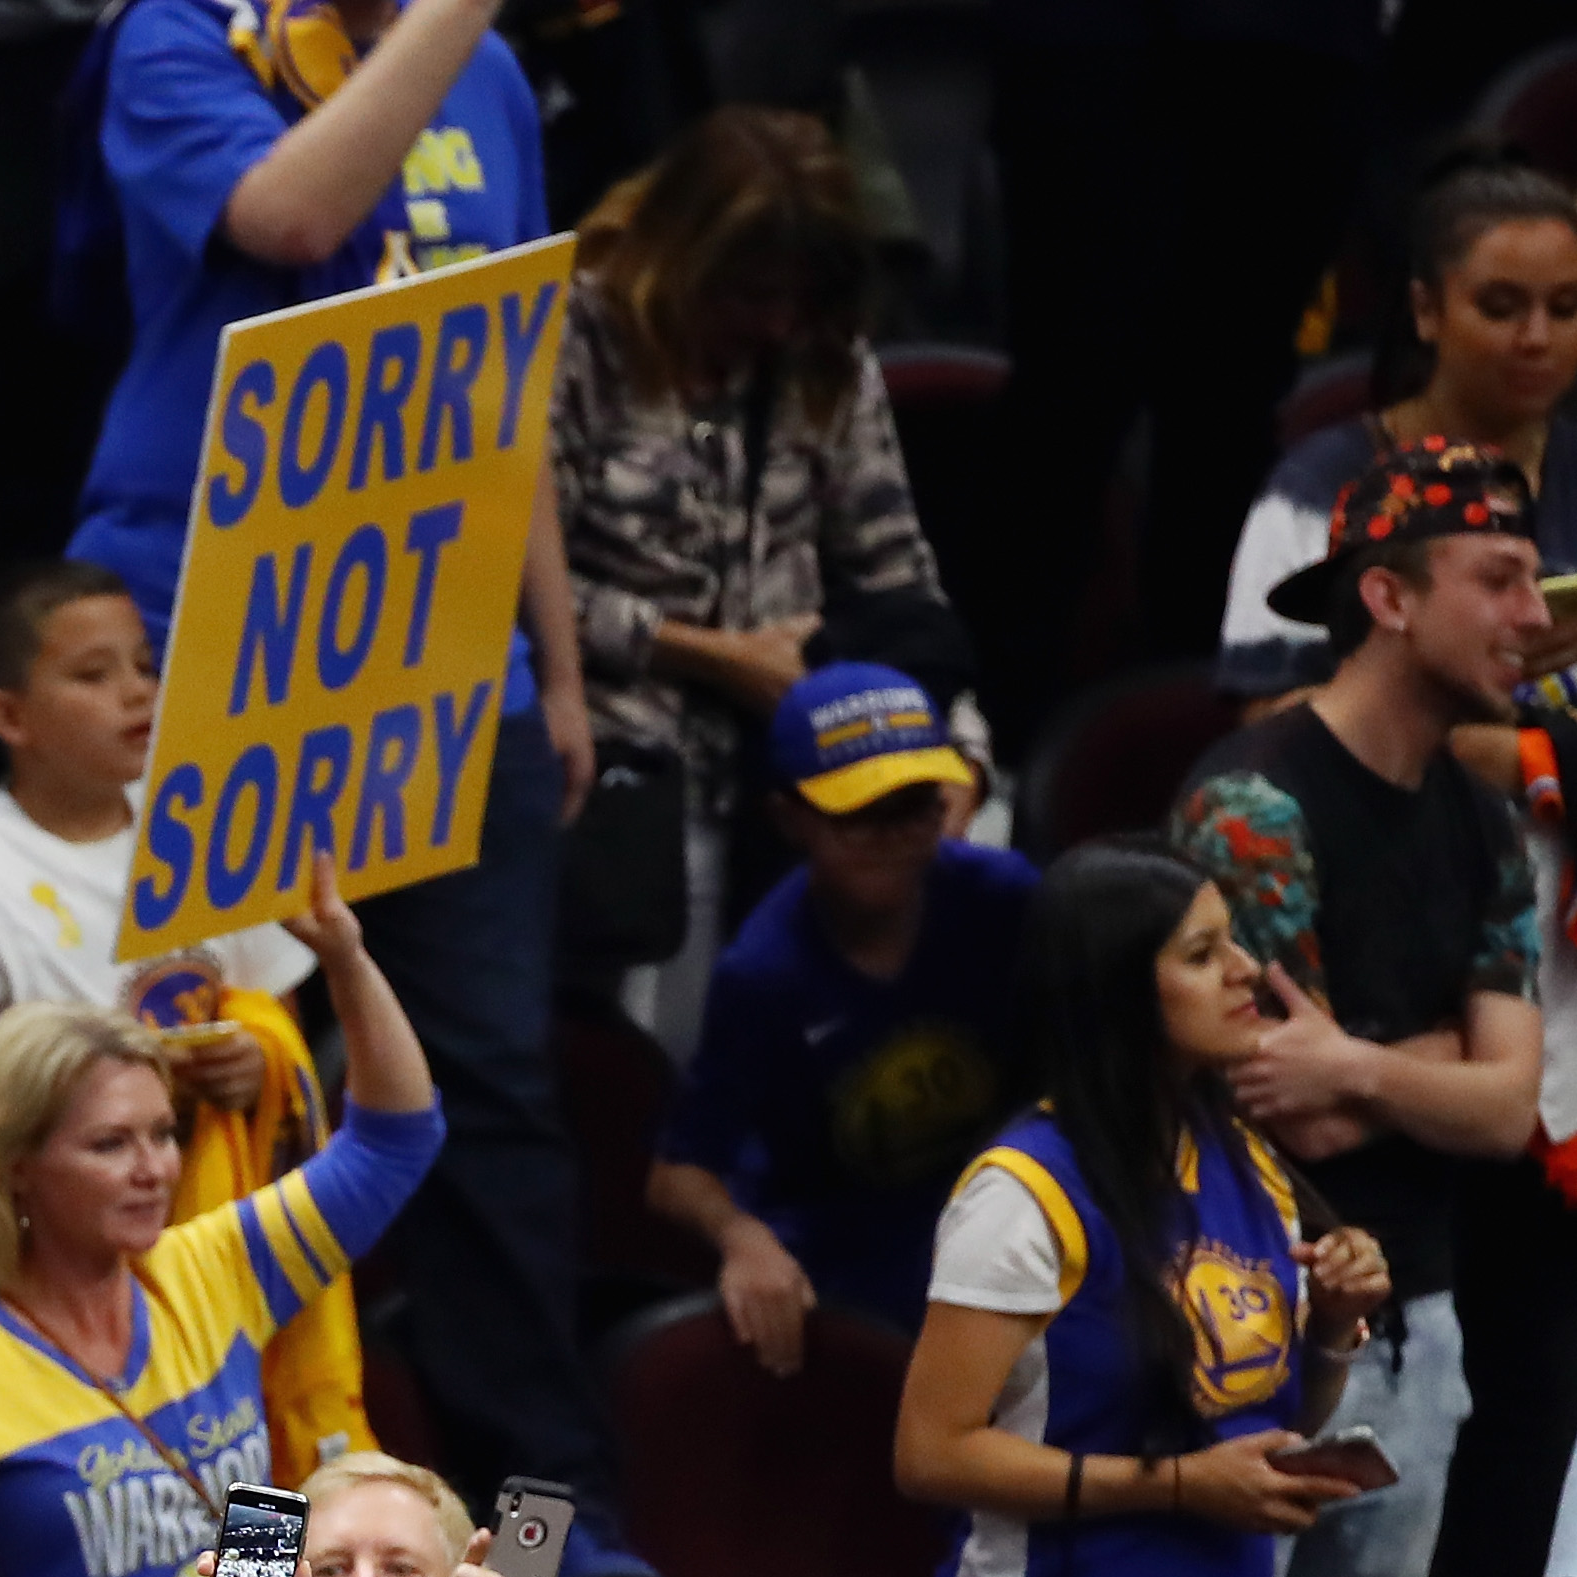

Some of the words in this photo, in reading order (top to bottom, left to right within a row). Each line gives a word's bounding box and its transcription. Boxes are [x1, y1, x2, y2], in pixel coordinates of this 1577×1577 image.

[208, 281, 559, 529] SORRY
[229, 503, 464, 716] NOT
[134, 681, 491, 930] SORRY
[1218, 1284, 1270, 1321] 30
